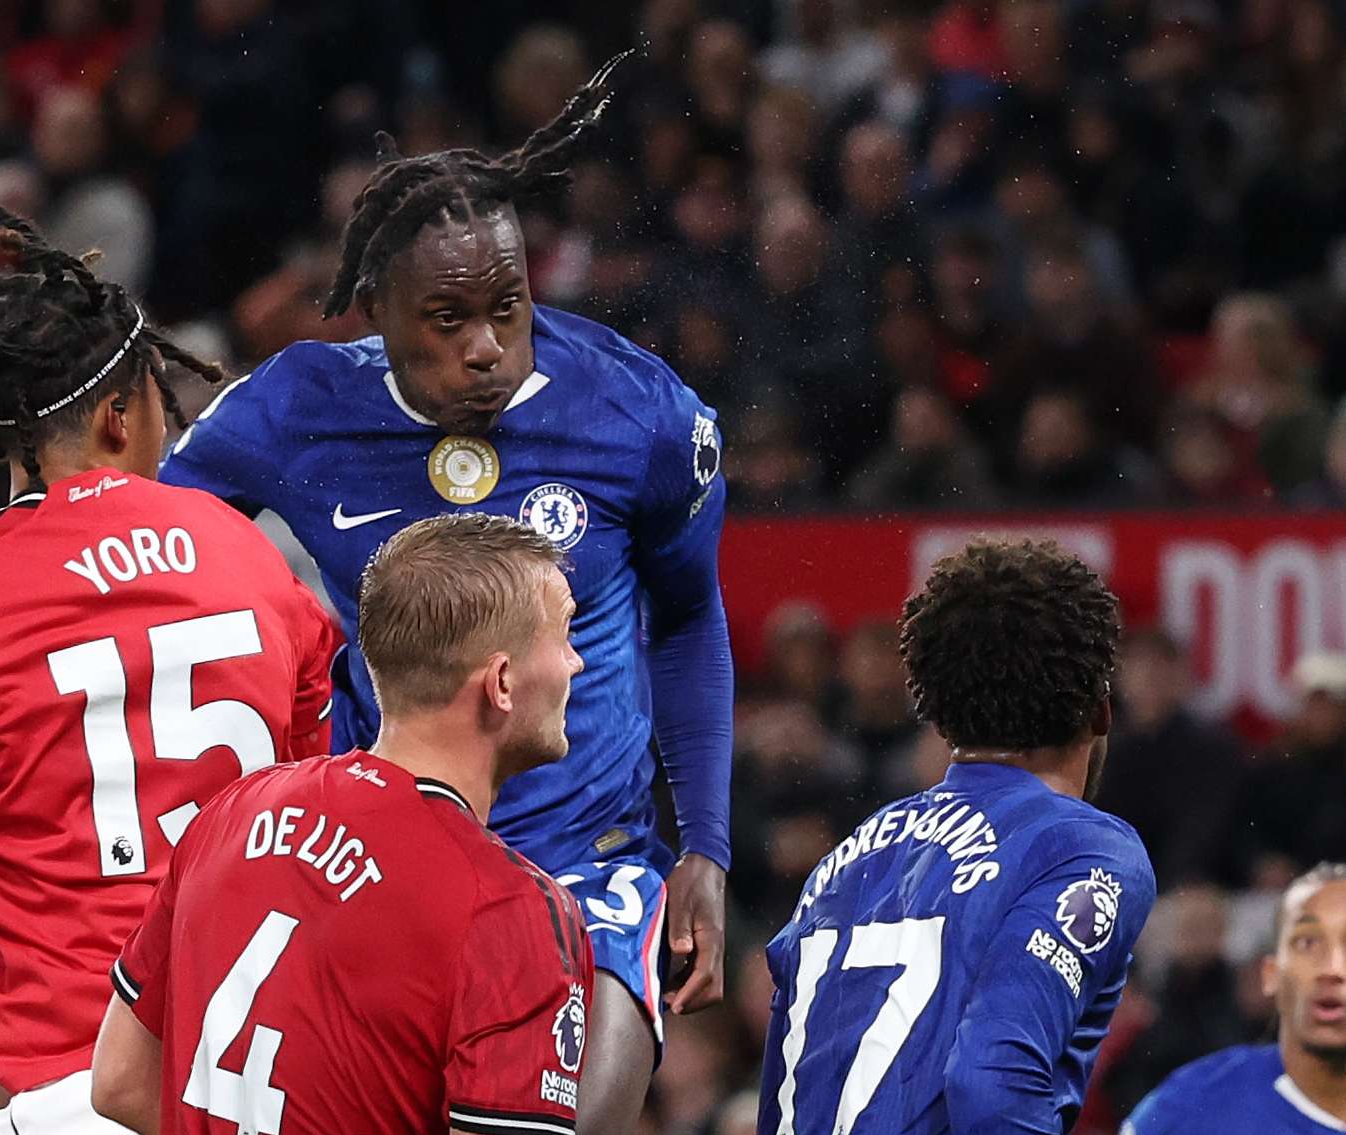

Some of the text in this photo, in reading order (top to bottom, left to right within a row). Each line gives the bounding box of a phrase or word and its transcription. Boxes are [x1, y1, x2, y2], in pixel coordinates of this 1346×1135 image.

[435, 443, 453, 475] WORLD
[449, 486, 476, 499] FIFA
[530, 486, 574, 502] CHELSEA
[64, 527, 198, 595] YORO
[47, 608, 277, 878] 15
[244, 806, 383, 902] DE LIGT
[1027, 928, 1083, 983] No room
[541, 1069, 578, 1097] No roo
